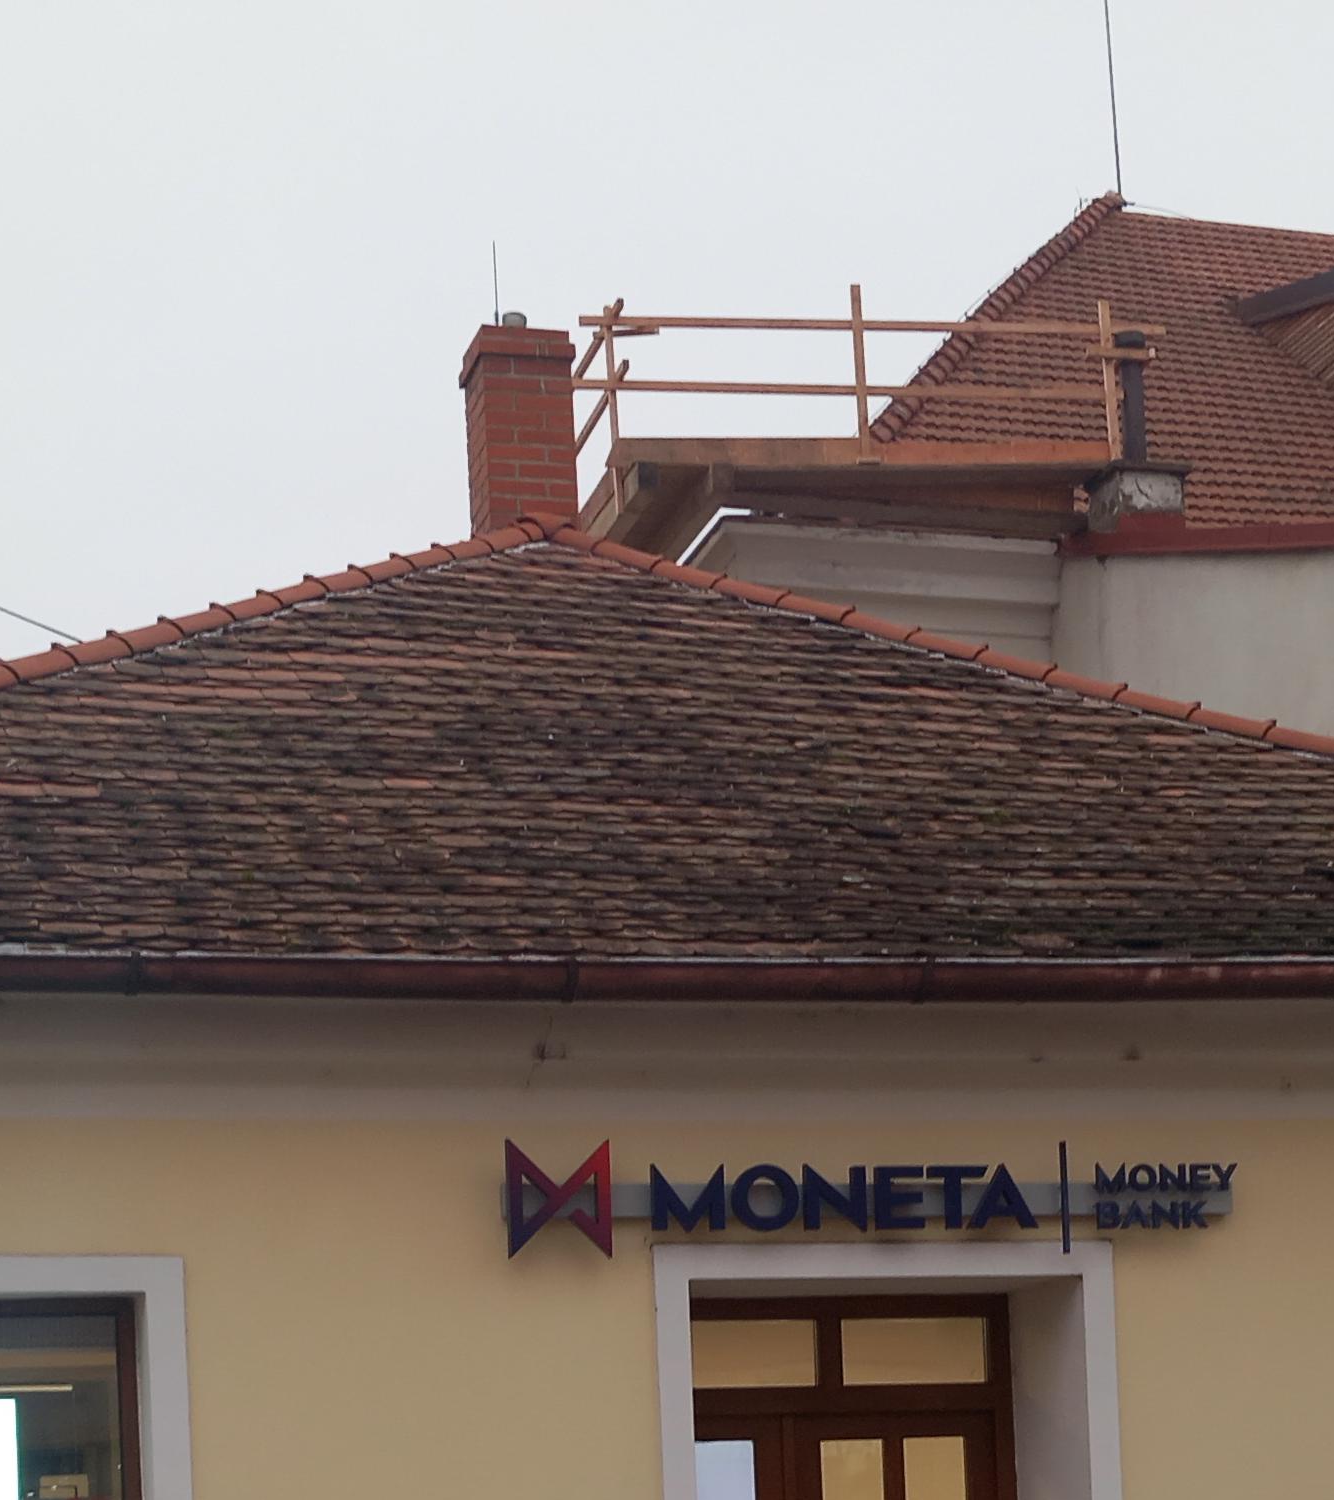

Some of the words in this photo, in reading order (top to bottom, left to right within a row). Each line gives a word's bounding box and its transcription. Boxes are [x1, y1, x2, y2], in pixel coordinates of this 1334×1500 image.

[1093, 1159, 1238, 1194] MONEY
[649, 1162, 1039, 1234] MONETA
[1094, 1198, 1210, 1231] BANK
